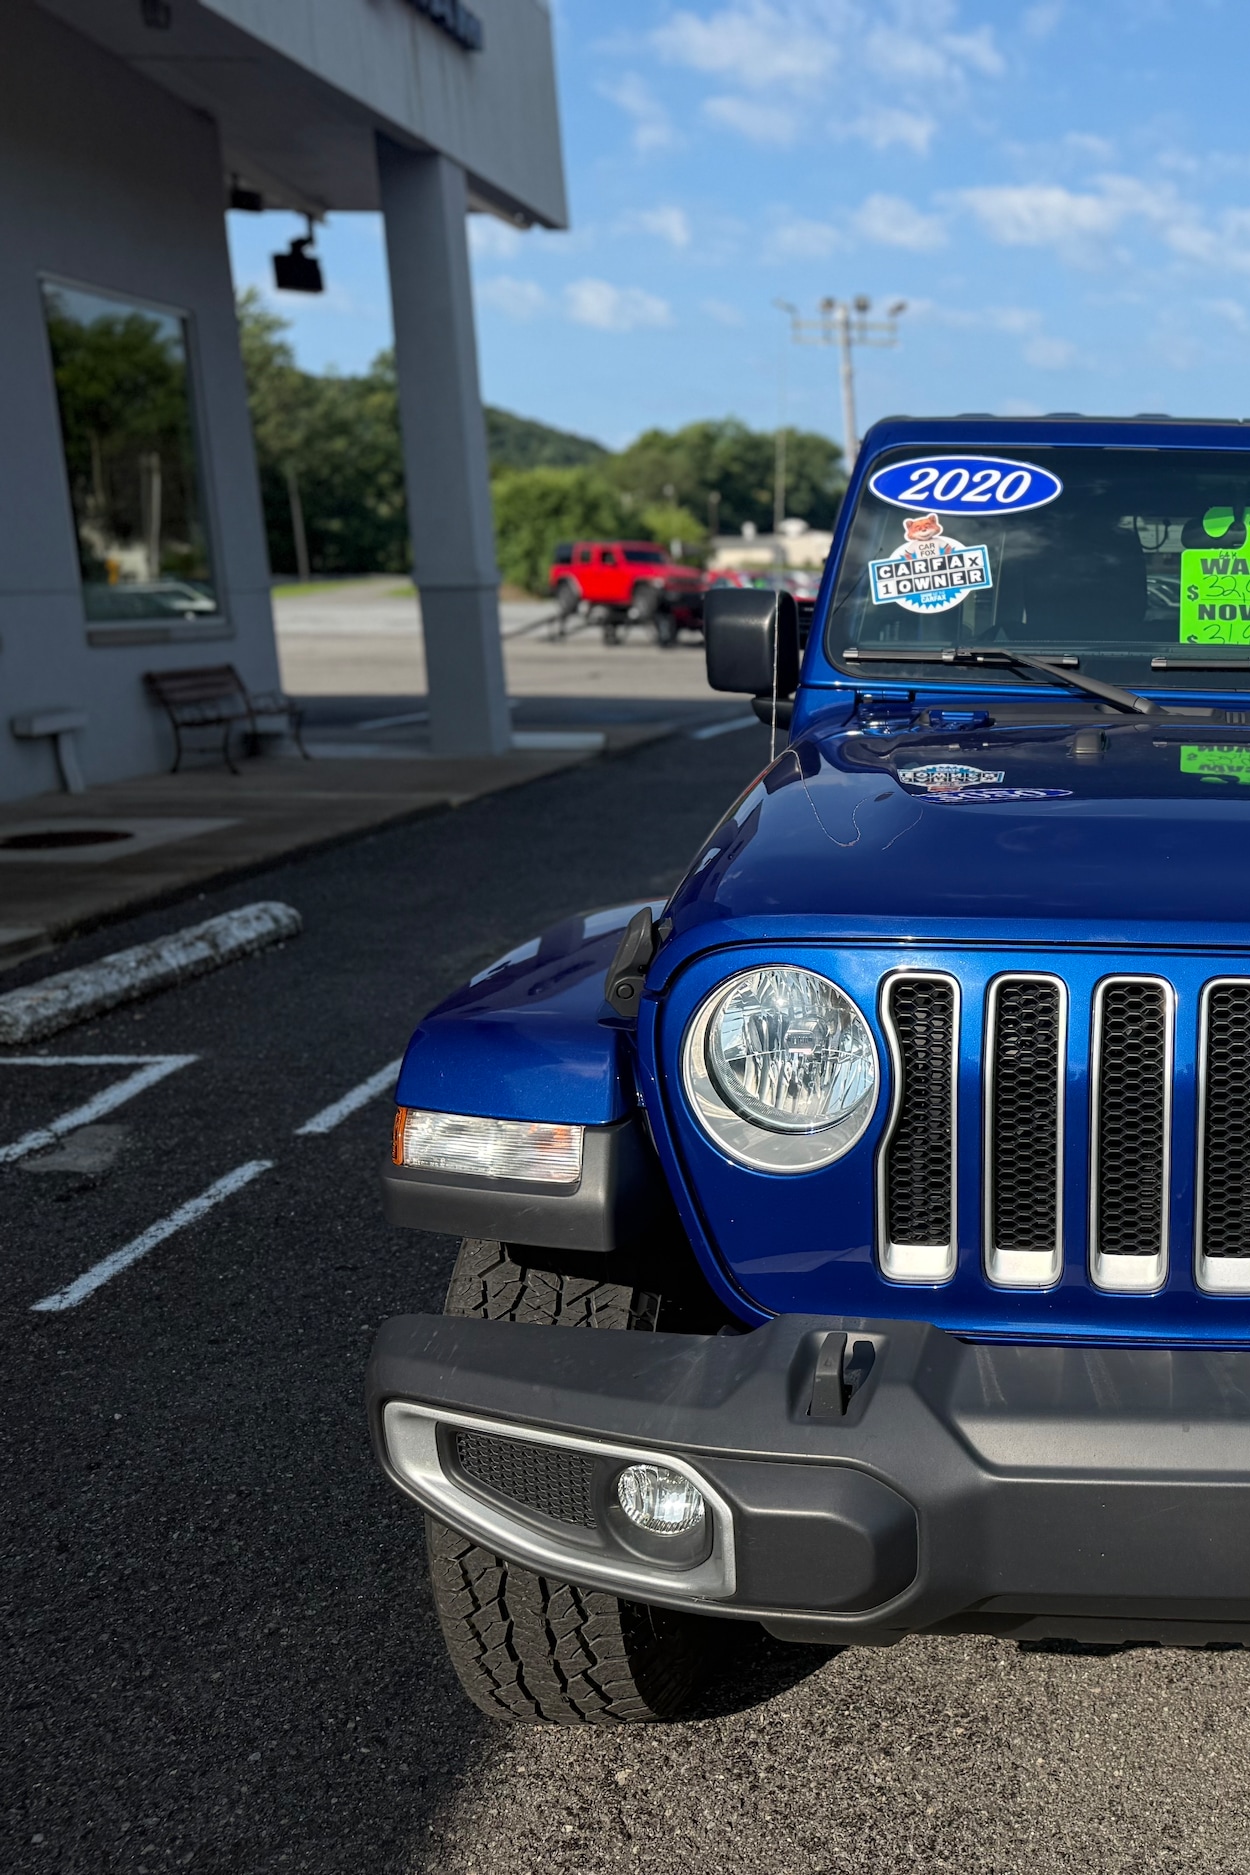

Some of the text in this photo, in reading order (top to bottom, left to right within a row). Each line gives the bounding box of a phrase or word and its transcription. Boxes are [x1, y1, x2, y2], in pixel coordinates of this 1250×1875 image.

[897, 467, 1032, 504] 2020
[918, 542, 936, 551] CAR
[920, 549, 936, 557] FOX
[878, 554, 980, 579] CARFAX
[882, 570, 983, 595] 1 OWNER
[1186, 584, 1199, 602] $
